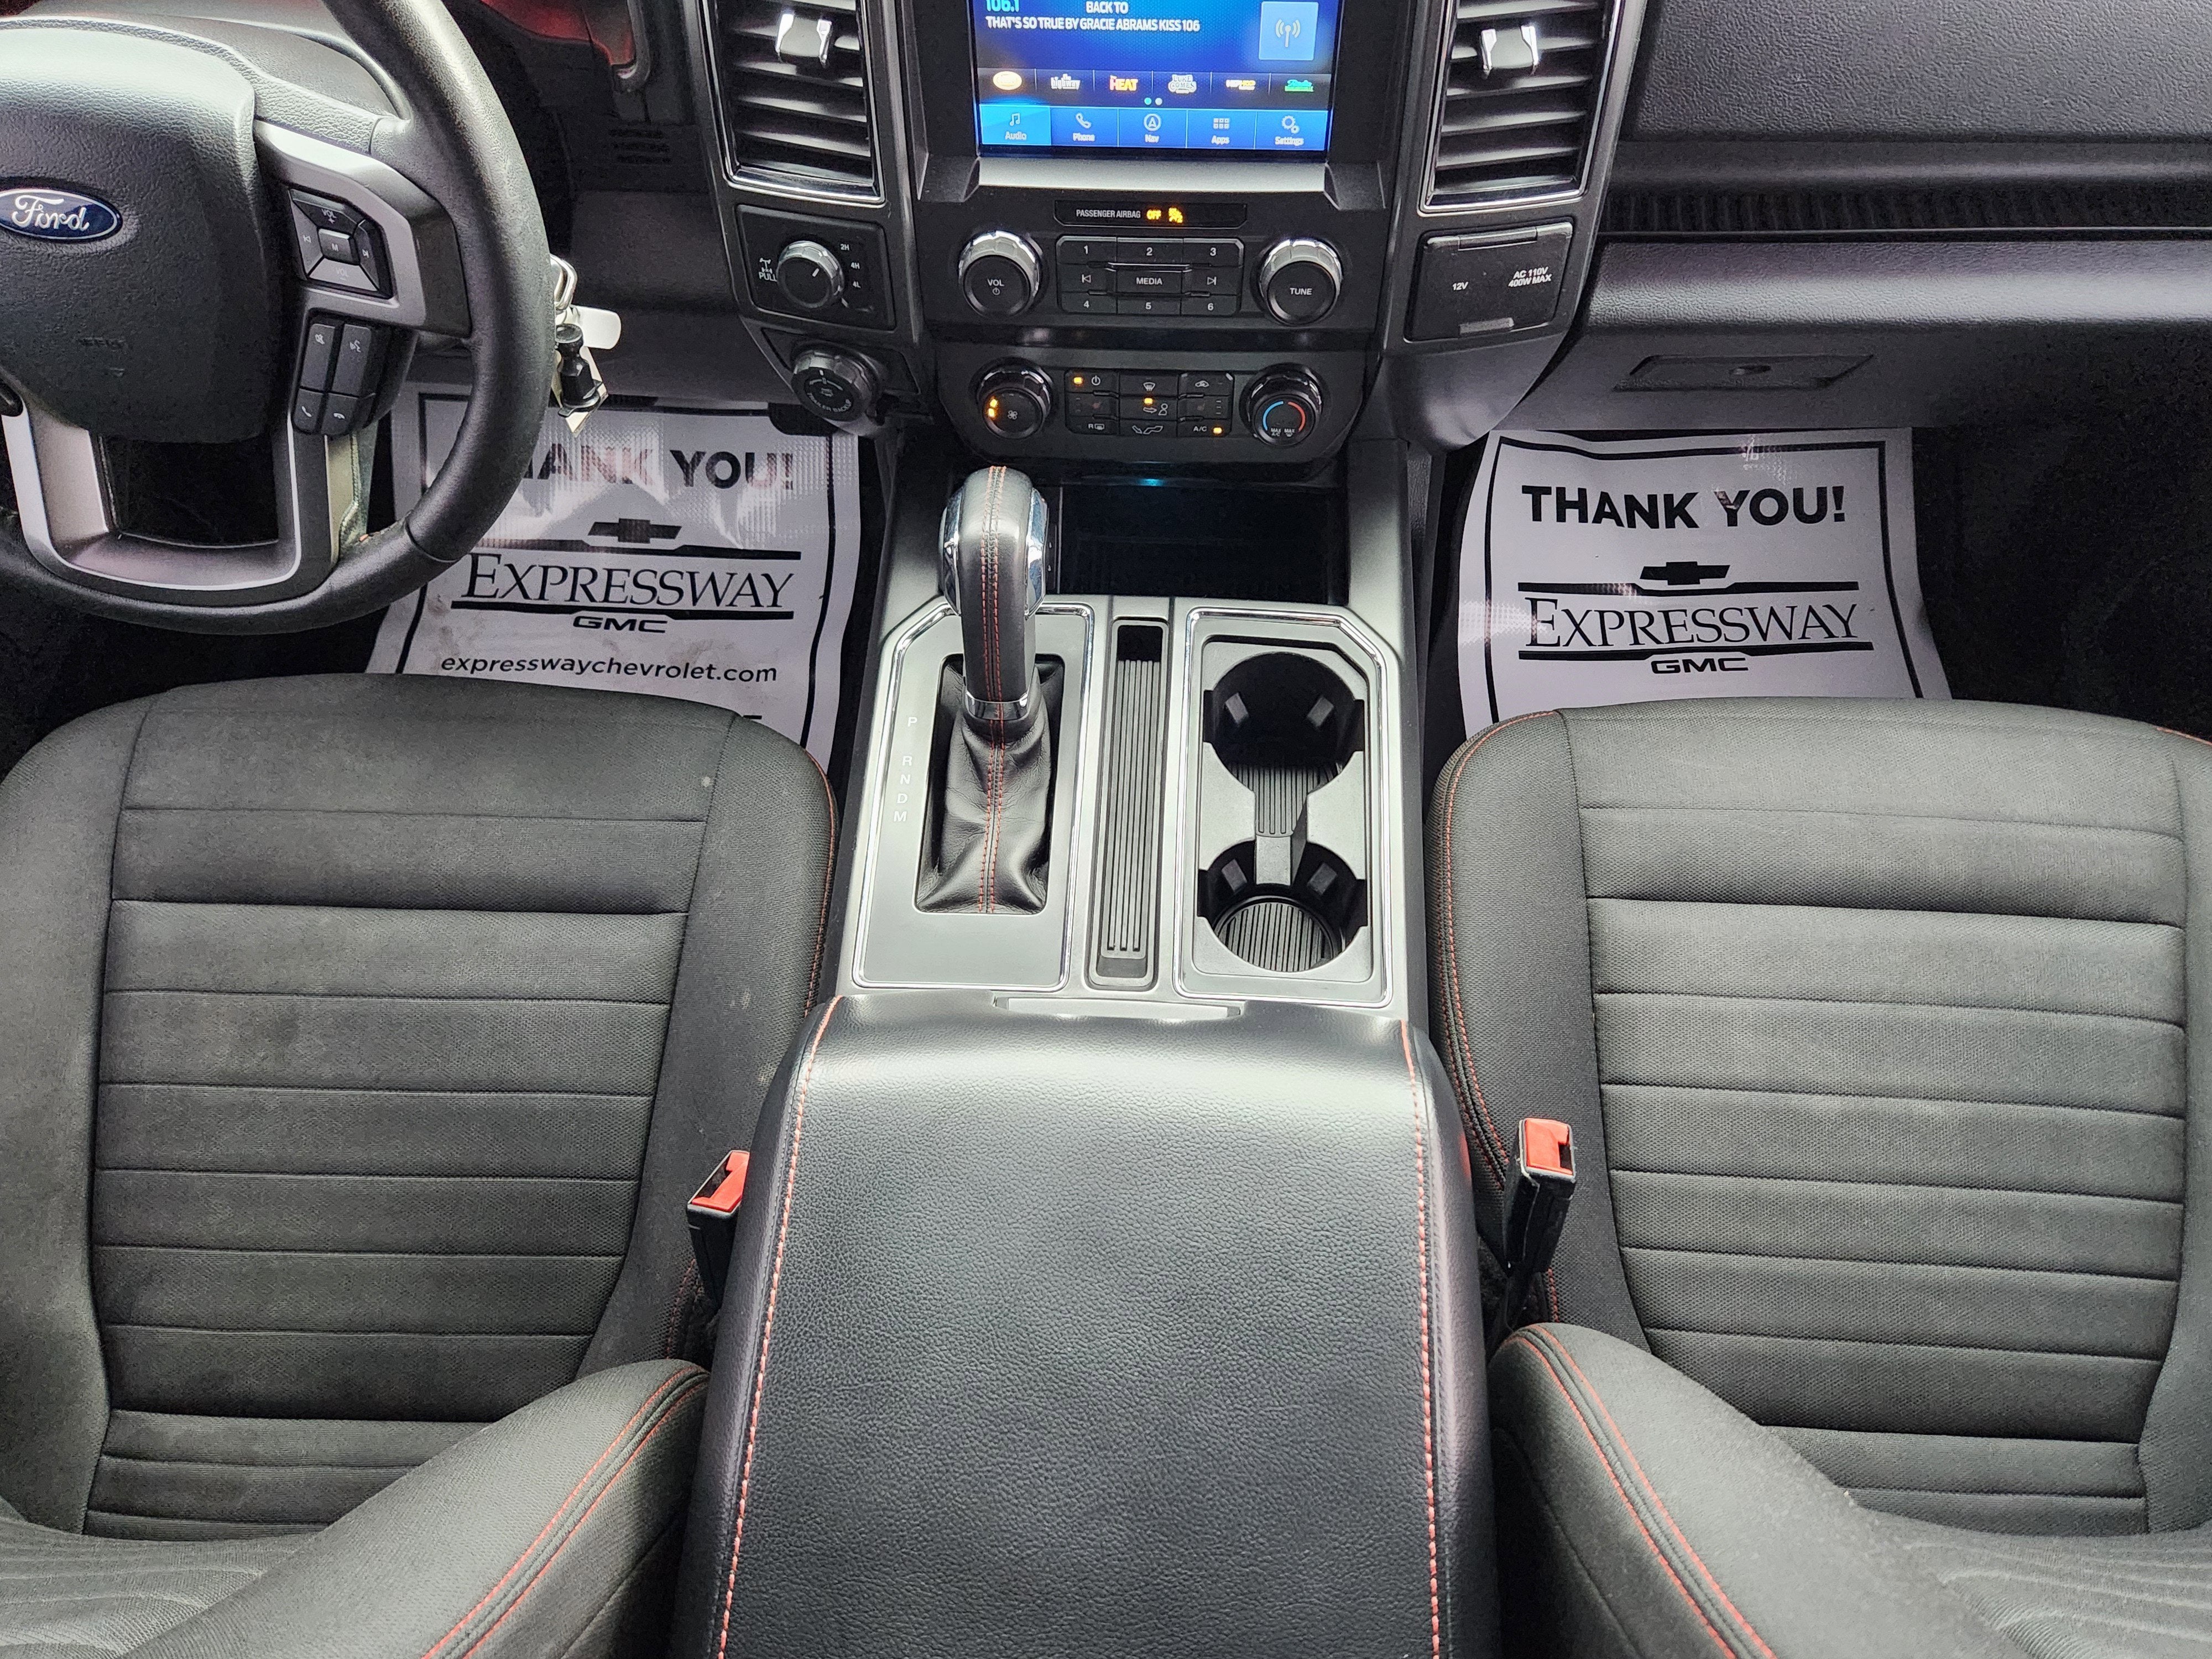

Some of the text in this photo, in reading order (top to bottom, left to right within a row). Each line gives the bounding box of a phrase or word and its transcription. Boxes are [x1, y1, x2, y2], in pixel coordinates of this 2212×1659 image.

[1086, 1, 1129, 14] BACK TO
[985, 16, 1201, 32] THAT'S SO TRUE BY GRACIE ABRAMS KISS 106
[1110, 79, 1139, 91] HEAT
[1005, 131, 1027, 140] Audio
[1073, 133, 1095, 142] Phone
[1145, 134, 1160, 143] Nav
[1212, 135, 1230, 145] Apps
[1275, 137, 1305, 146] Settings
[12, 195, 90, 231] Ford
[321, 208, 337, 218] VOL
[1076, 209, 1141, 218] PASSENGER AIRBAG
[1146, 209, 1161, 220] OFF
[331, 243, 339, 252] M
[1083, 245, 1089, 254] 1
[1146, 247, 1153, 256] 2
[1210, 247, 1217, 257] 3
[759, 272, 778, 282] PULL
[1513, 267, 1548, 279] AC 110V
[1136, 277, 1162, 285] MEDIA
[1452, 281, 1469, 291] 12V
[1508, 274, 1552, 288] 400W MAX
[1290, 287, 1312, 295] TUNE
[1083, 300, 1089, 309] 4
[807, 393, 832, 411] TRAILER
[523, 443, 794, 491] ANK YOU!
[1522, 484, 1846, 530] THANK YOU!
[461, 553, 795, 608] EXPRESSWAY
[572, 615, 667, 634] GMC
[1525, 596, 1858, 648] EXPRESSWAY
[441, 656, 777, 683] expresswaychevrolet.com
[1651, 657, 1749, 675] GMC
[907, 716, 918, 727] P
[902, 755, 913, 766] R
[900, 774, 910, 784] N
[896, 794, 909, 804] D
[893, 811, 908, 822] M
